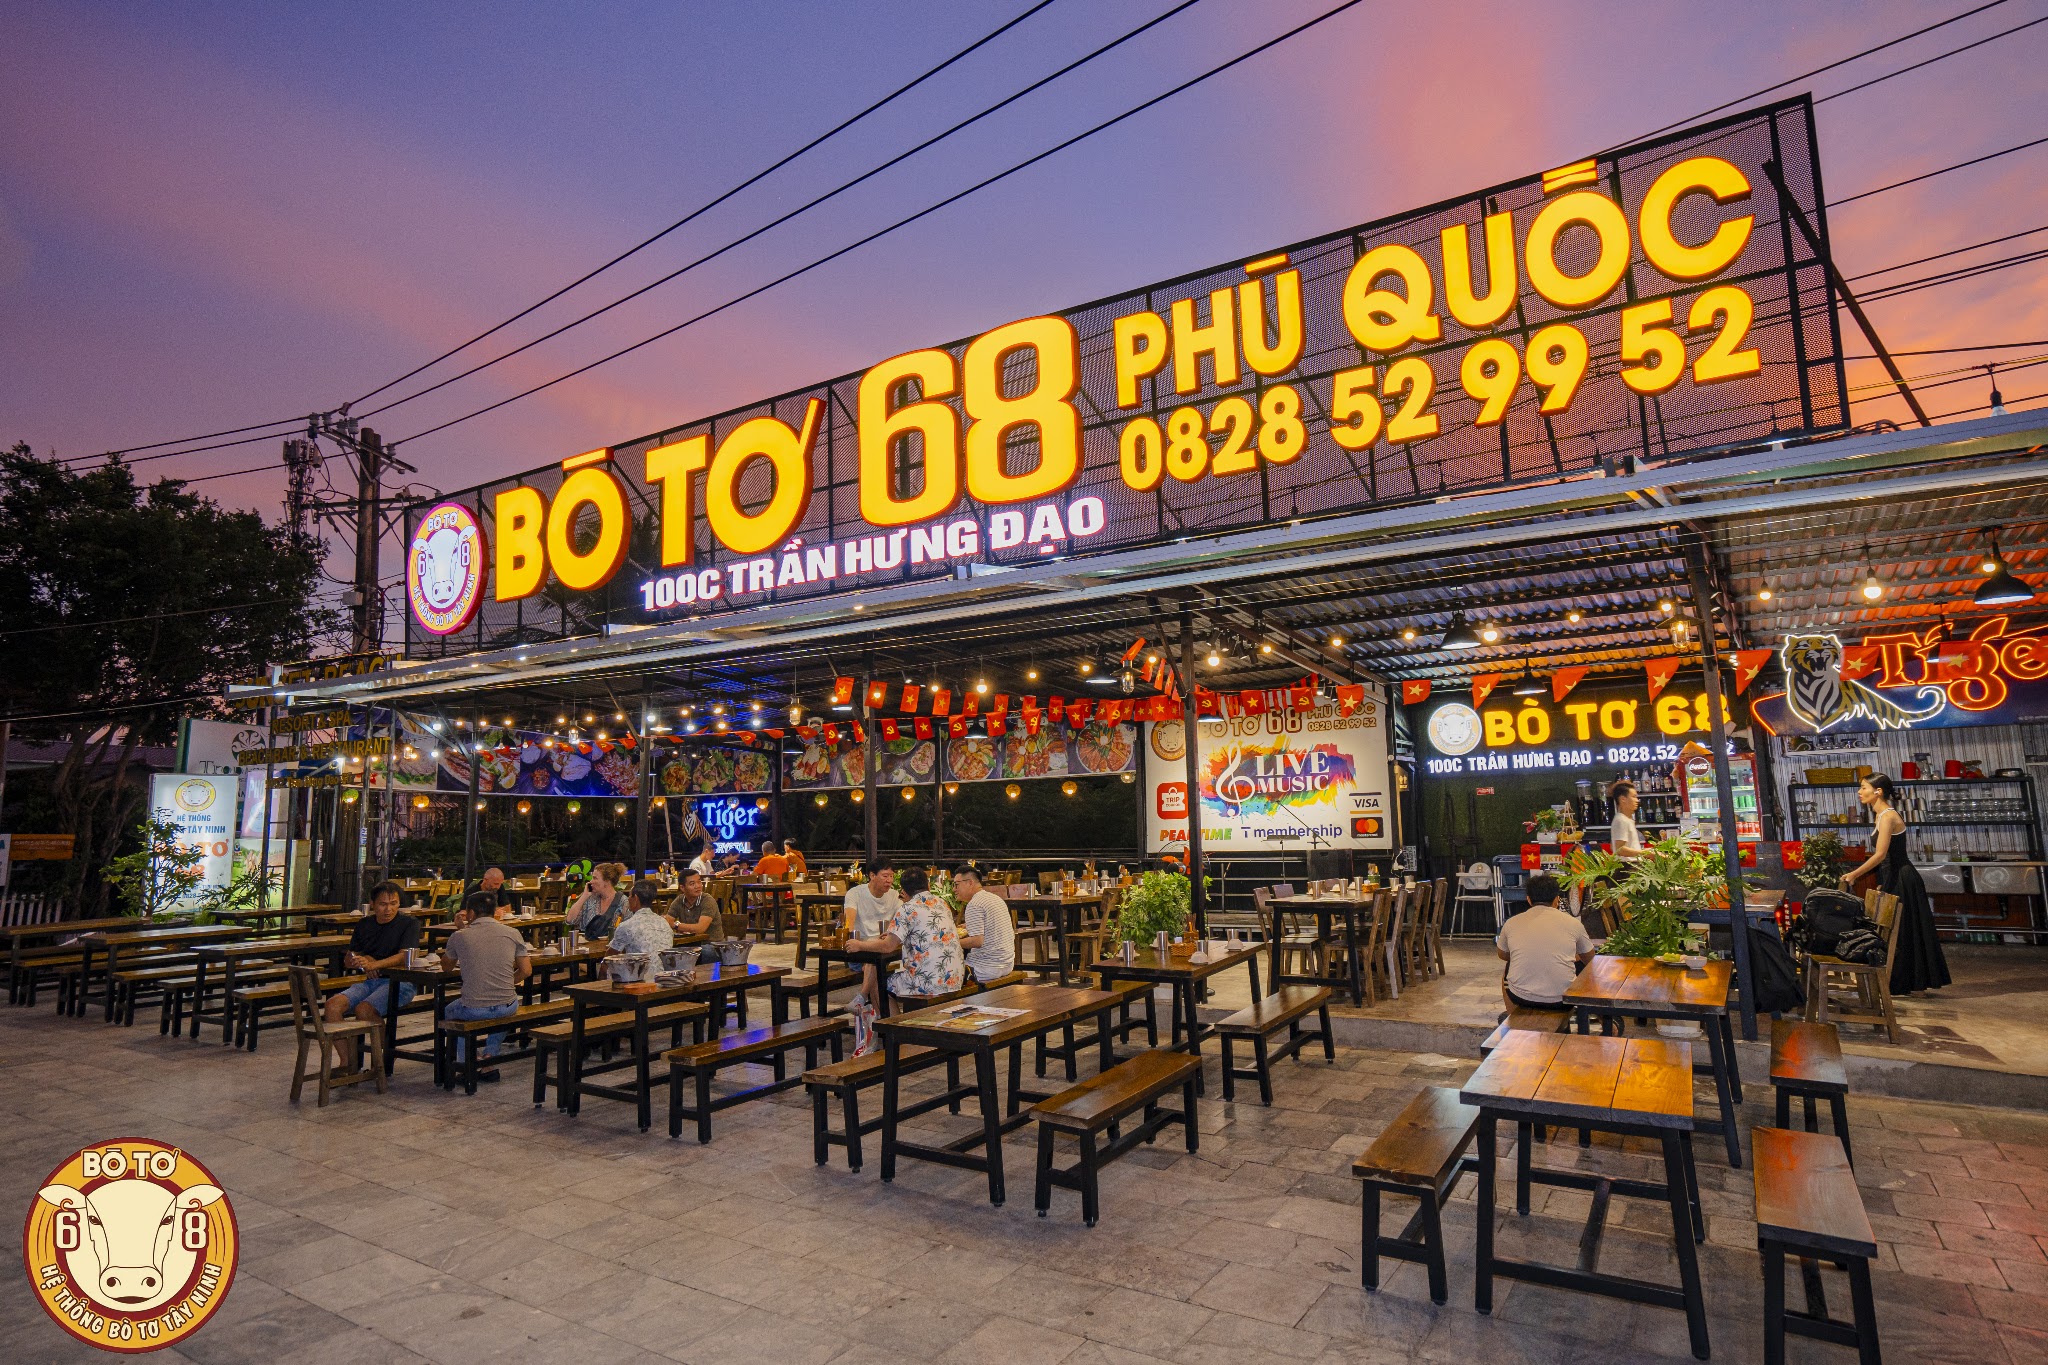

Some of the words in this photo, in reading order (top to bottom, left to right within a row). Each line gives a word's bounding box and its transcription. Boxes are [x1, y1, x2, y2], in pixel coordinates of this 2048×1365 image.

[1118, 385, 1308, 492] 0828
[1330, 356, 1440, 451] 52
[1458, 322, 1591, 427] 99
[1620, 284, 1762, 393] 52
[856, 316, 1081, 528] 68
[417, 551, 427, 576] 6
[460, 541, 471, 567] 8
[639, 567, 722, 611] 100C
[727, 537, 838, 598] TRẦN
[844, 519, 980, 578] HƯNG
[988, 496, 1107, 556] ĐẠO
[1862, 617, 2048, 713] Tige
[271, 714, 316, 735] RESORT
[329, 710, 351, 727] SPA
[1266, 705, 1303, 735] 68
[1307, 721, 1332, 732] 0828
[1333, 719, 1347, 730] 52
[1348, 718, 1361, 729] 99
[1363, 717, 1377, 728] 52
[1484, 698, 1551, 747] BÒ
[1565, 699, 1638, 741] TƠ
[1656, 693, 1730, 735] 68
[312, 736, 391, 760] RESTAURANT
[1255, 751, 1330, 777] LIVE
[1427, 758, 1463, 774] 100C
[1512, 751, 1555, 769] HƯNG
[1558, 749, 1592, 768] ĐẠO
[1256, 775, 1329, 794] MUSIC
[1352, 798, 1380, 808] VISA
[204, 825, 226, 834] NINH
[702, 799, 759, 840] Tiger
[1253, 824, 1343, 839] membership
